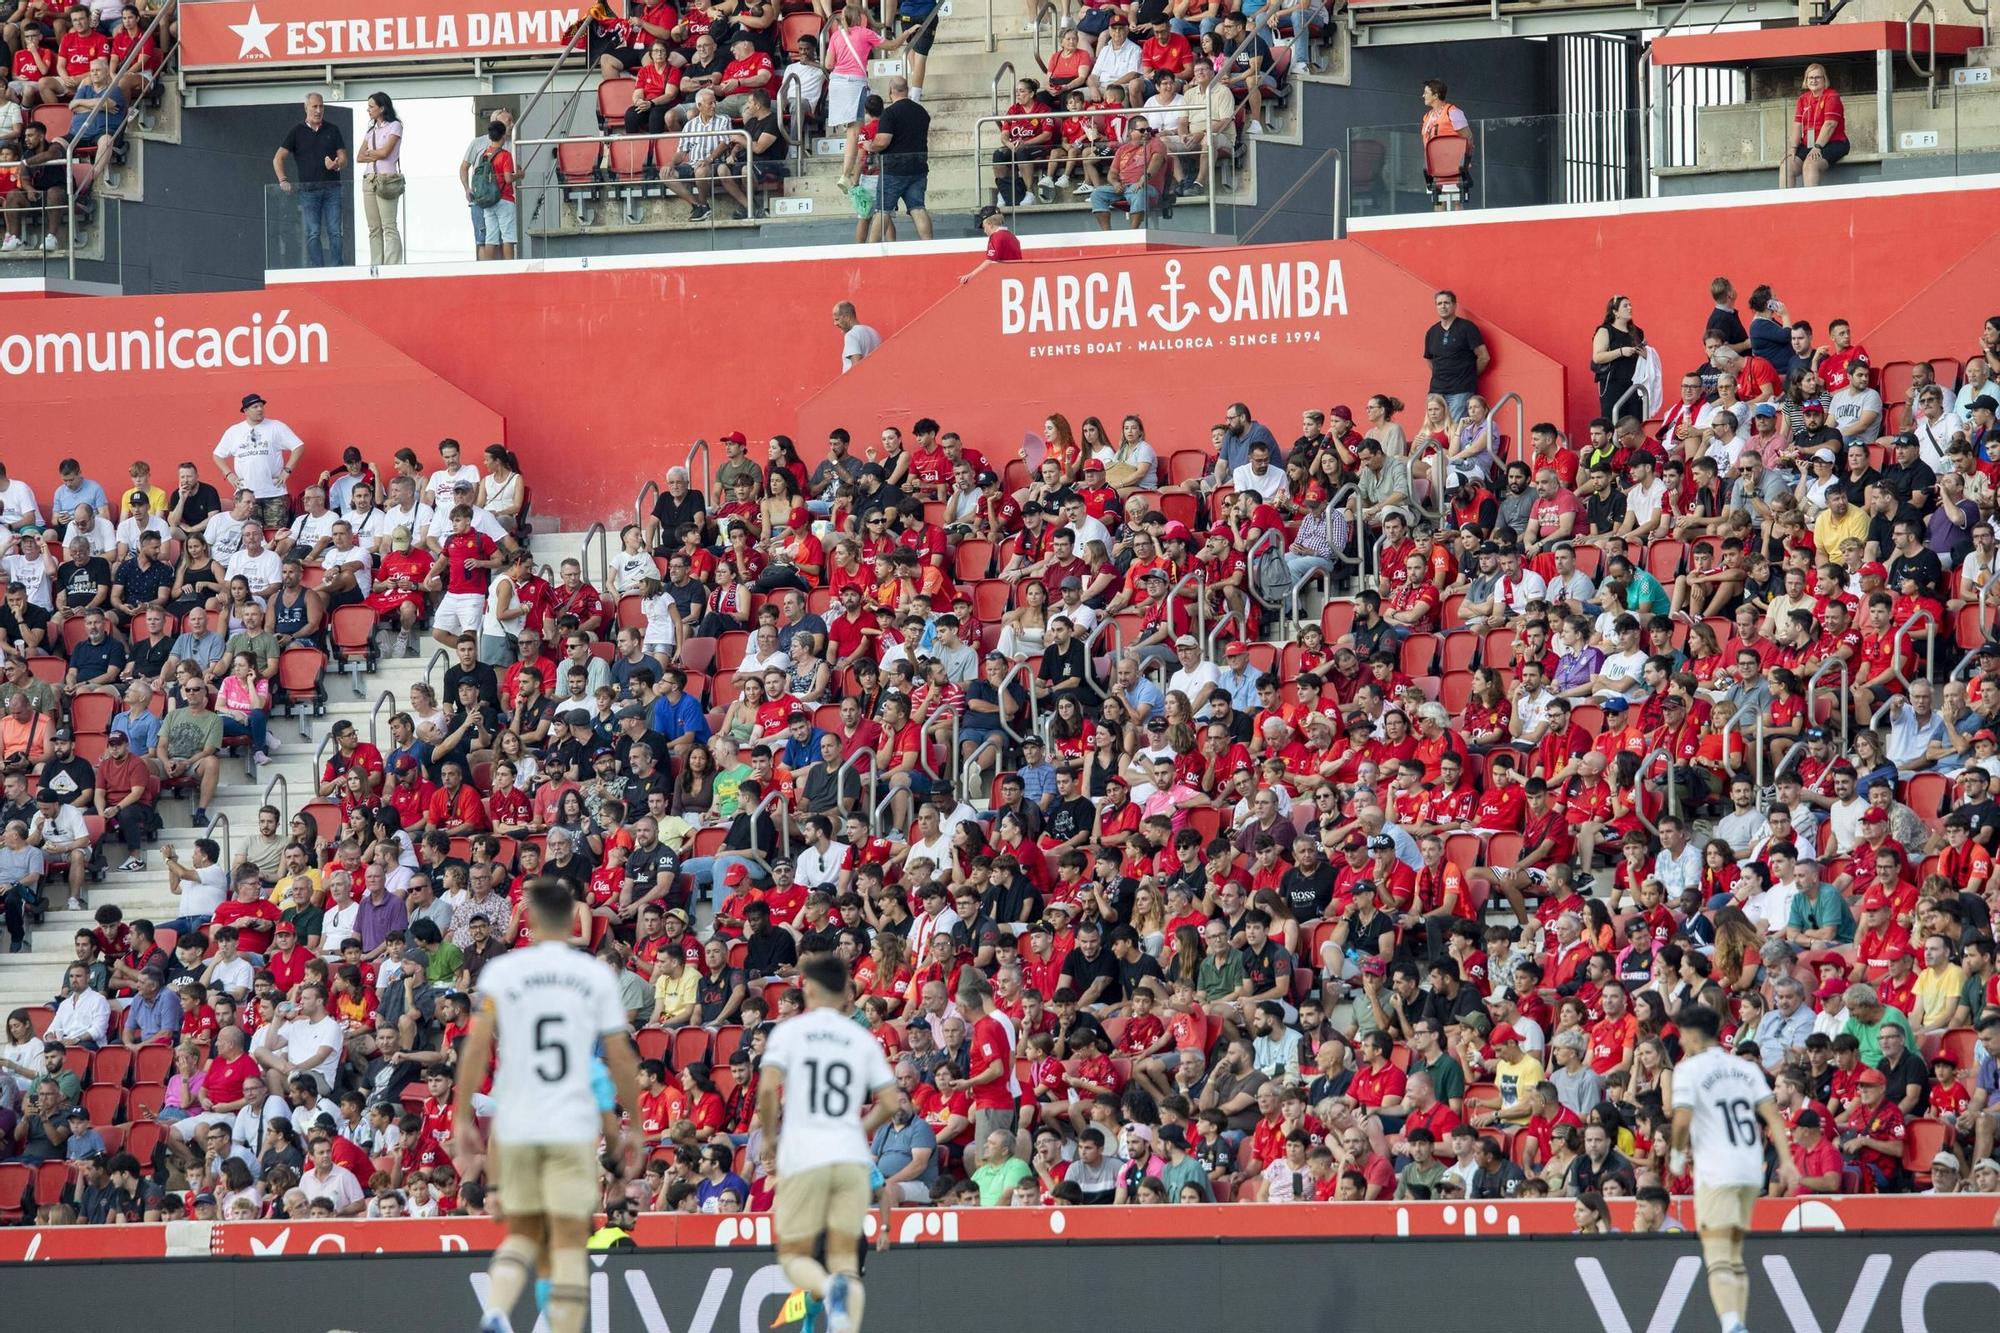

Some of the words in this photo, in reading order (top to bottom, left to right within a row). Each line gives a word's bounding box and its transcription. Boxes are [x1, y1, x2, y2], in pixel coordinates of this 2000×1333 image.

[286, 18, 459, 55] ESTRELLA
[467, 8, 580, 47] DAMM
[1001, 271, 1138, 335] BARCA
[1208, 259, 1349, 324] SAMBA
[1029, 345, 1081, 357] EVENTS
[1087, 341, 1123, 354] BOAT
[1138, 336, 1214, 352] MALLORCA
[1229, 333, 1278, 347] SINCE
[1286, 331, 1321, 343] 1994
[792, 702, 803, 710] OK
[1629, 738, 1642, 747] OK
[1186, 772, 1198, 782] OK
[782, 782, 792, 790] OK
[660, 857, 672, 865] OK
[1973, 860, 1987, 870] OK
[1446, 877, 1458, 886] OK
[1290, 889, 1316, 901] BOSS
[1656, 927, 1668, 936] OK
[687, 948, 698, 957] OK
[860, 968, 874, 978] OK
[535, 1014, 568, 1083] 5
[803, 1059, 851, 1118] 18
[1715, 1098, 1757, 1147] 16
[422, 1152, 434, 1160] OK
